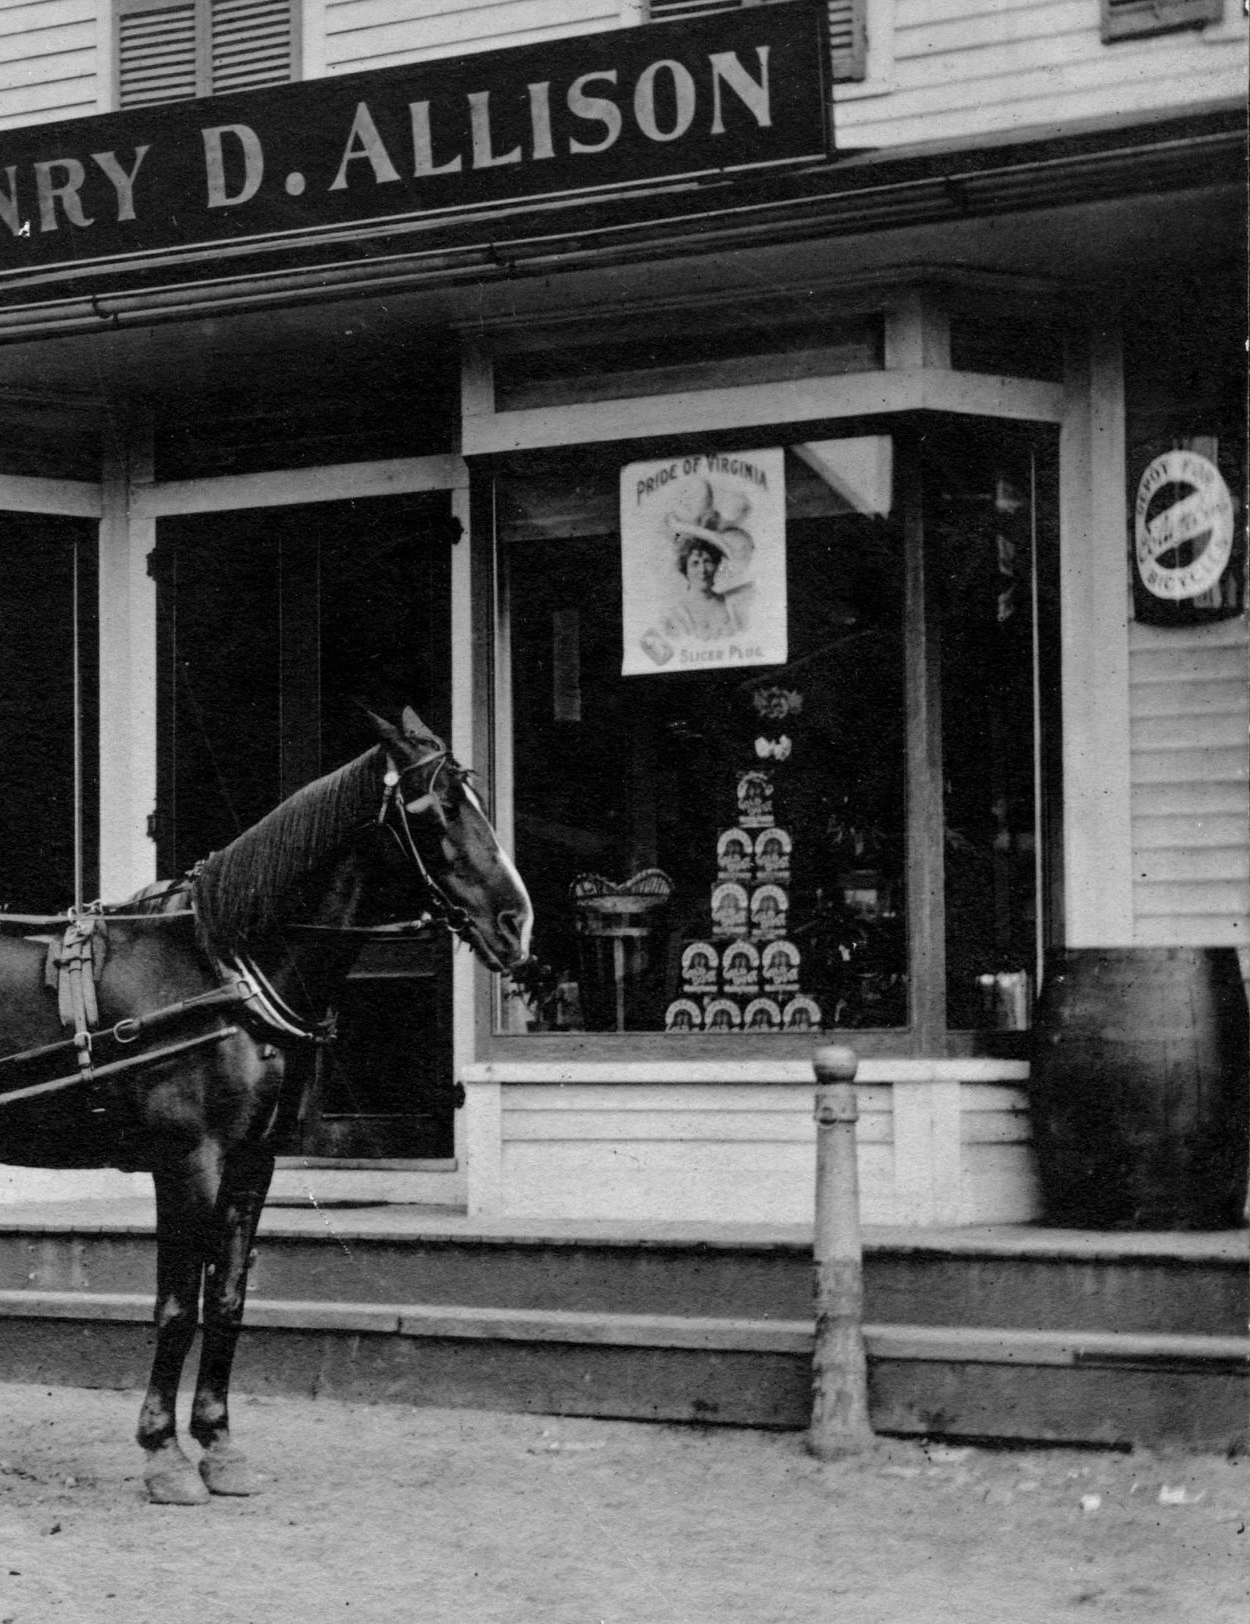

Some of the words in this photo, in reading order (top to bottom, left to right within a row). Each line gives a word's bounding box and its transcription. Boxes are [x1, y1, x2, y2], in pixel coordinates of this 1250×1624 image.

[201, 122, 307, 209] D.
[327, 45, 773, 191] ALLISON
[636, 463, 679, 506] PRIDE
[682, 456, 701, 476] OF
[706, 453, 769, 491] VIRGINIA
